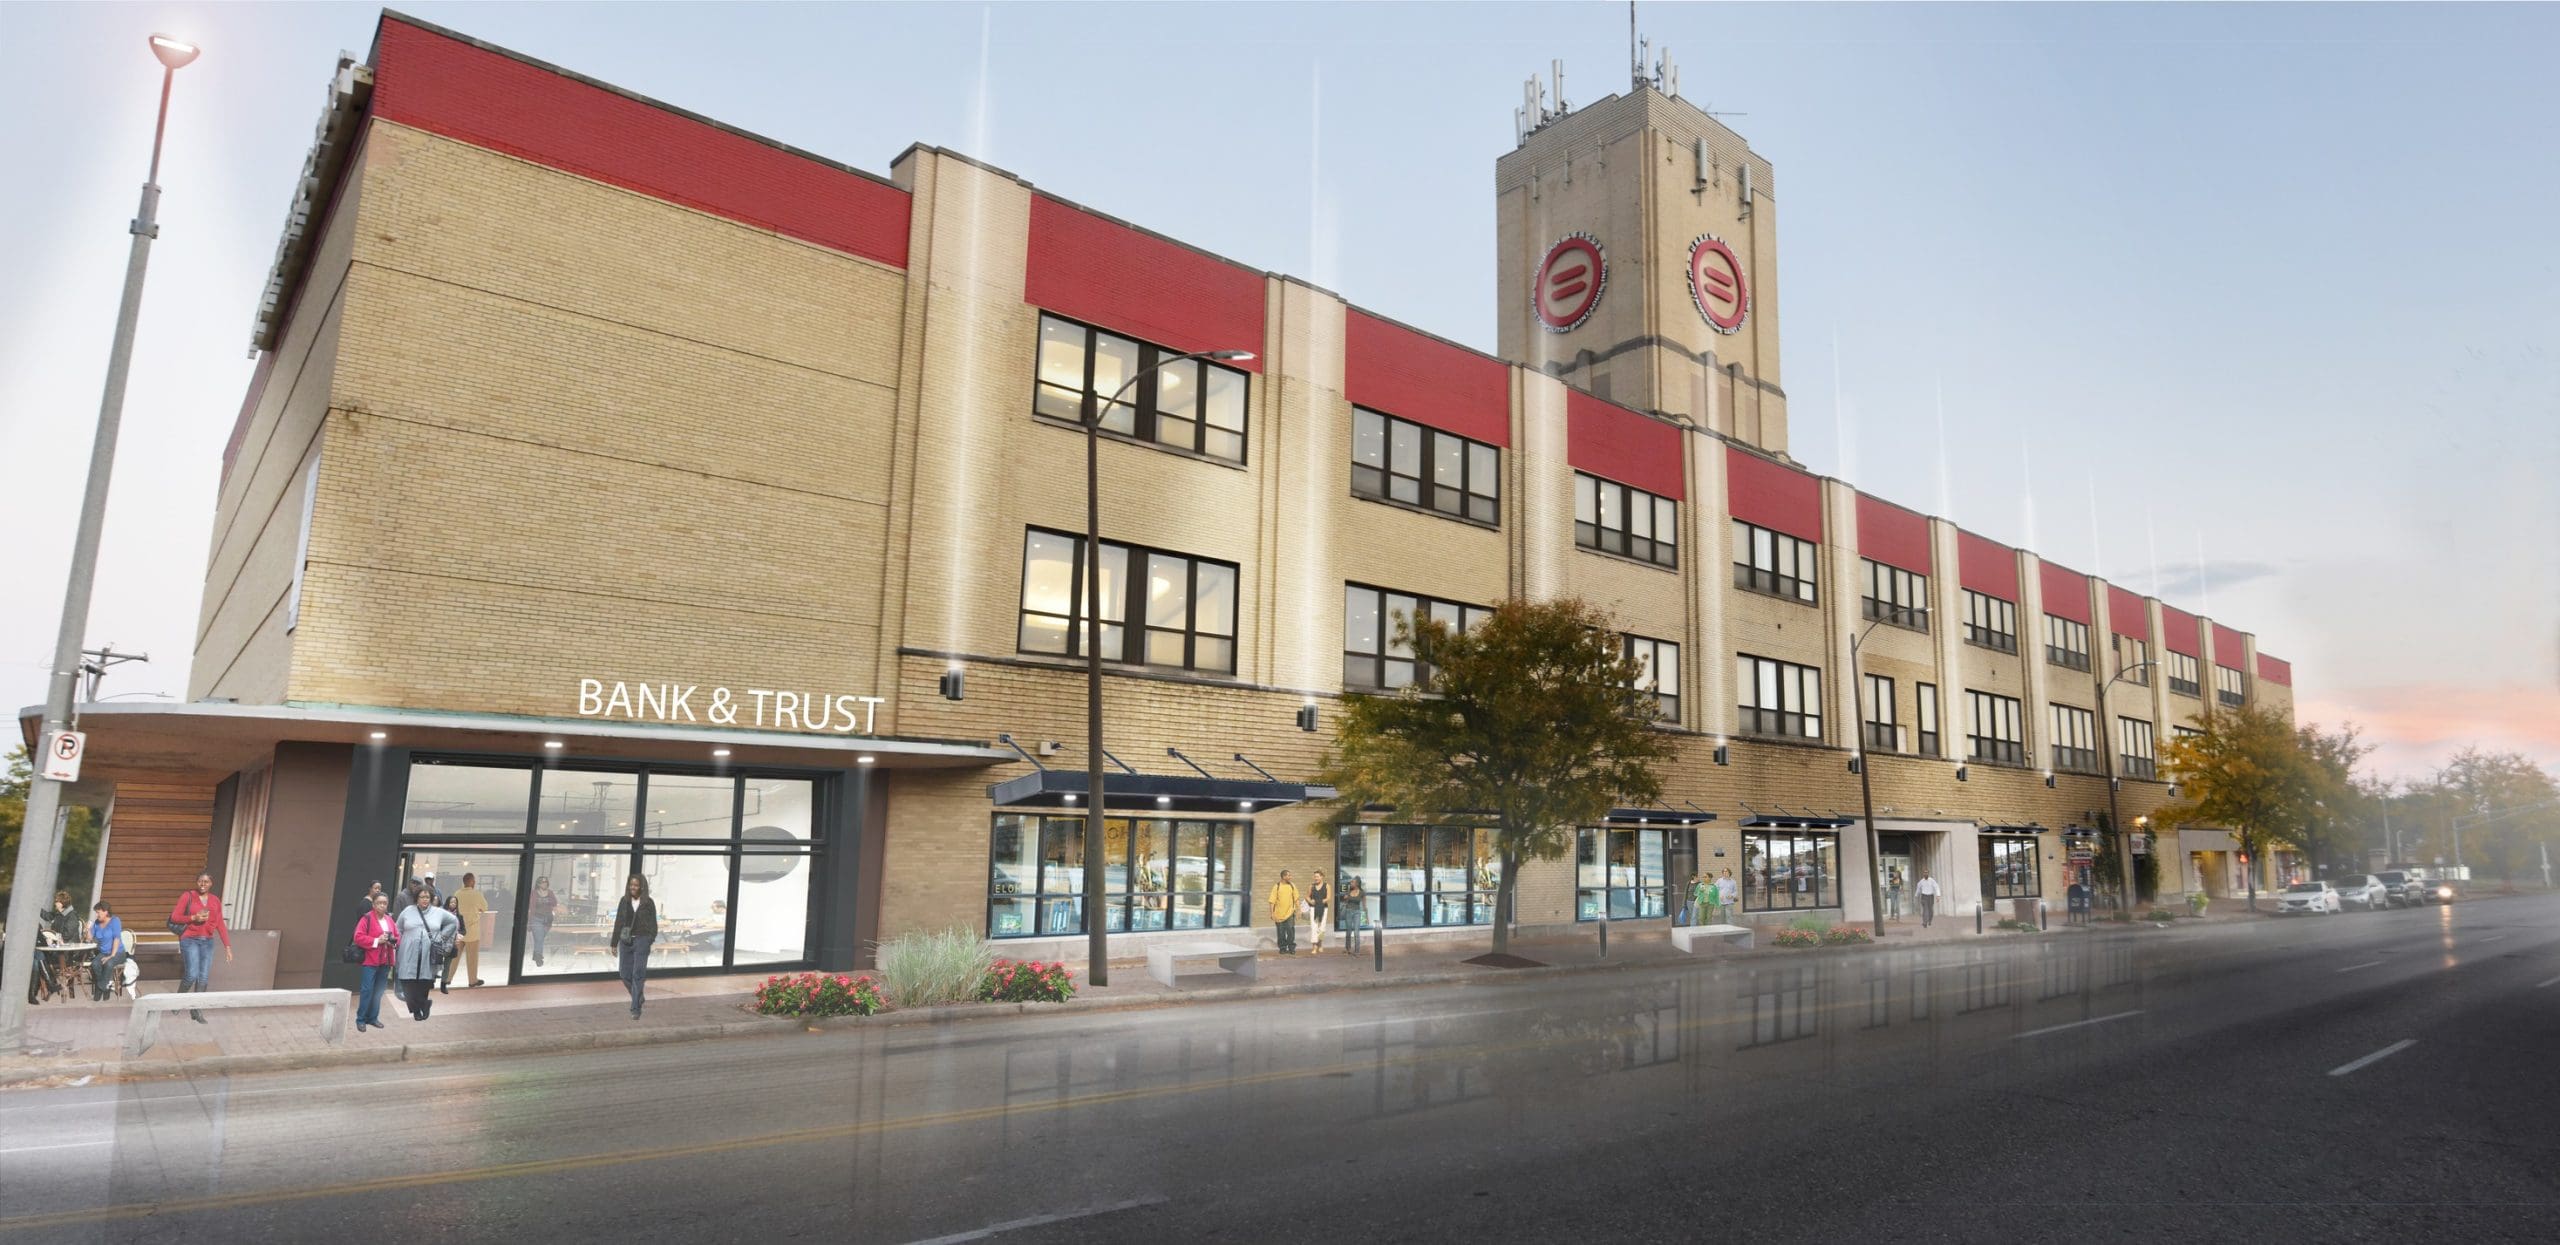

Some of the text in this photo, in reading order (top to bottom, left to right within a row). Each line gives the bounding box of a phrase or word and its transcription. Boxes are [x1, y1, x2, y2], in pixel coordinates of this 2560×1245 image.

[579, 678, 886, 733] BANK & TRUST
